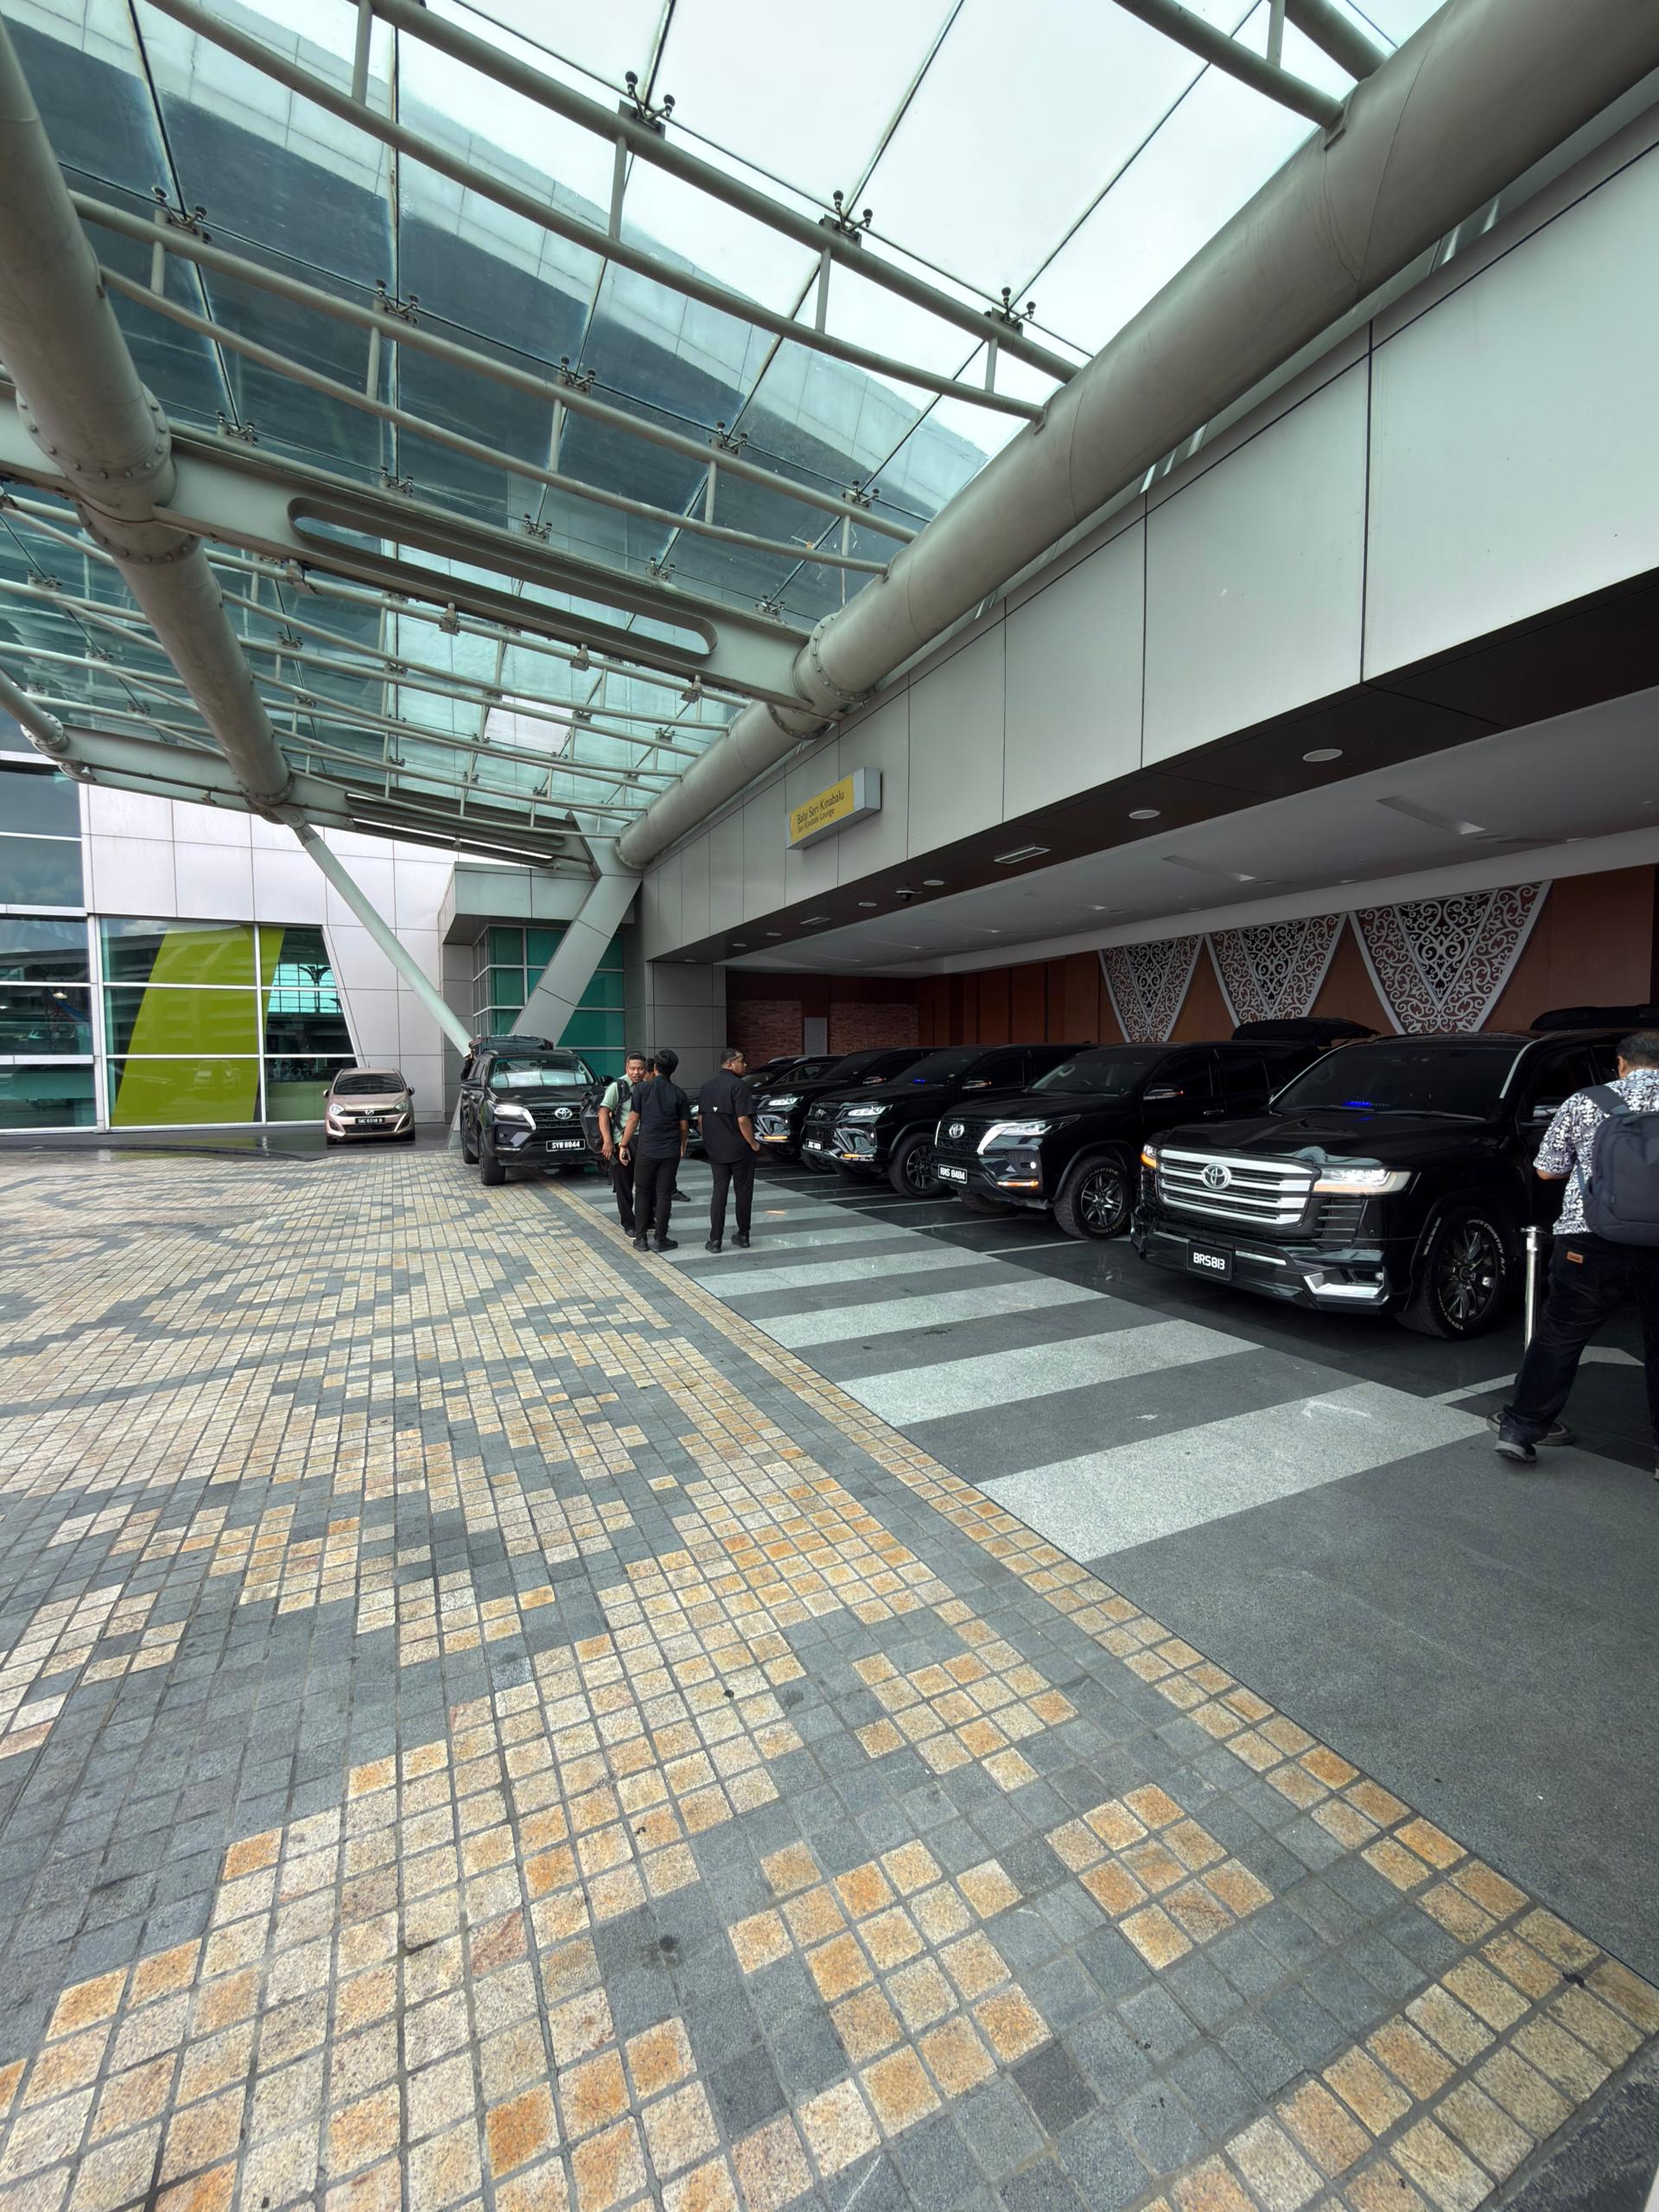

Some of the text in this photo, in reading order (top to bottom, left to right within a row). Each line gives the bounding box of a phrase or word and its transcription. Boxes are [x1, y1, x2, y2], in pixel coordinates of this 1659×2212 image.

[809, 805, 819, 817] Seri
[820, 790, 844, 811] Kinabalu
[1193, 1252, 1225, 1270] BRS813
